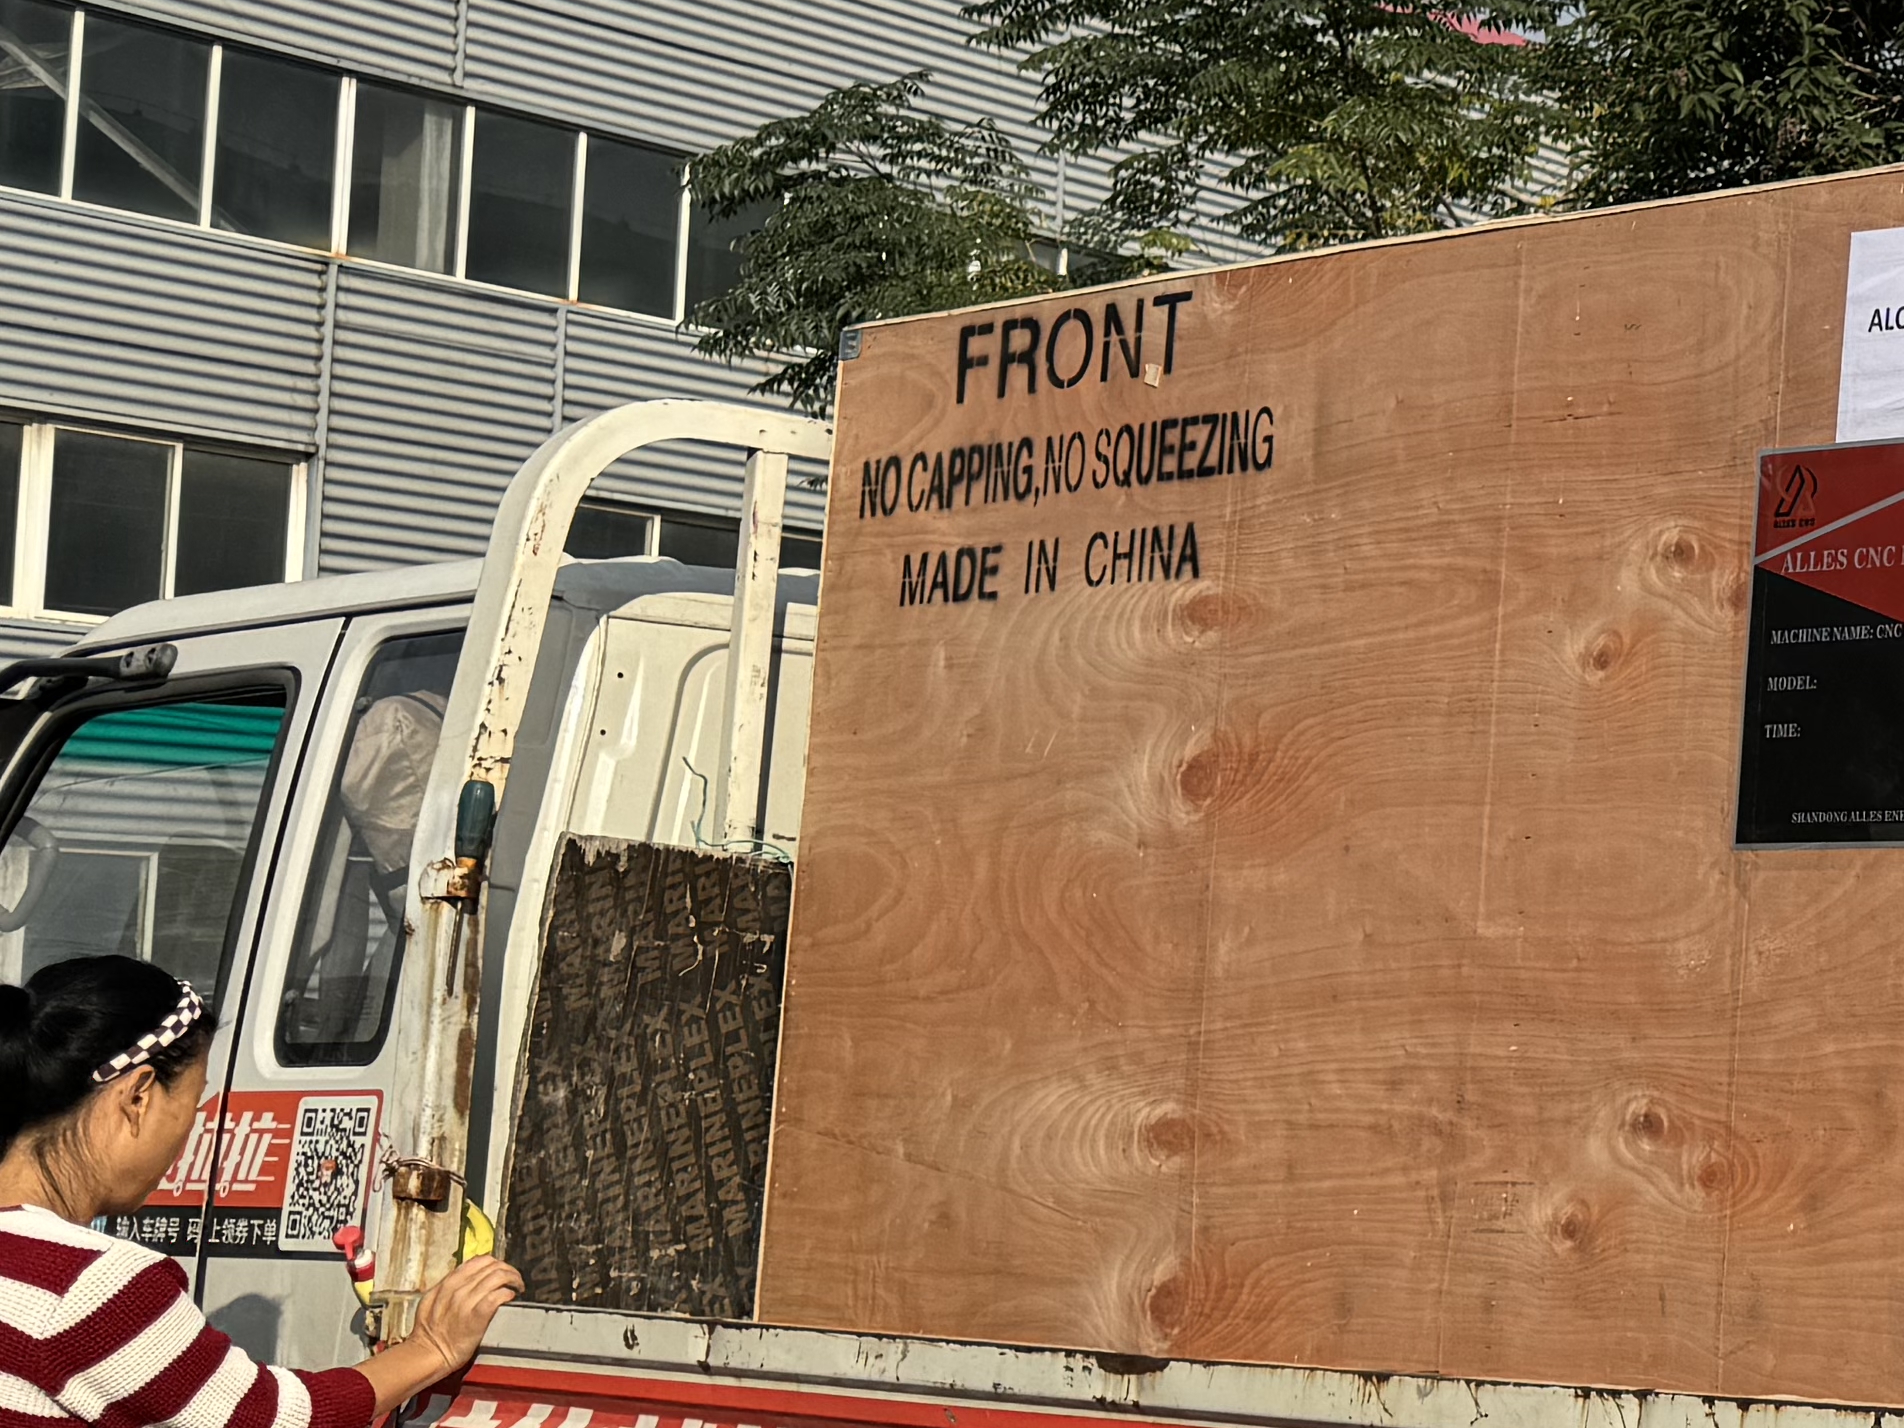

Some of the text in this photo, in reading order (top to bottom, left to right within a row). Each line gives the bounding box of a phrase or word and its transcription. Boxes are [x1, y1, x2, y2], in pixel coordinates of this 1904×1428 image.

[955, 290, 1194, 405] FRONT
[859, 455, 900, 520] NO
[1094, 405, 1275, 490] SQUEEZING
[899, 521, 1201, 607] MADE IN CHINA
[1780, 548, 1848, 575] ALLES
[1853, 545, 1896, 570] CNC
[1770, 627, 1831, 645] MACHINE
[1832, 624, 1874, 642] NAME:
[1876, 622, 1903, 639] CNC
[1767, 675, 1818, 692] MODEL:
[1764, 723, 1802, 739] TIME:
[678, 993, 752, 1237] MARINEPLEX
